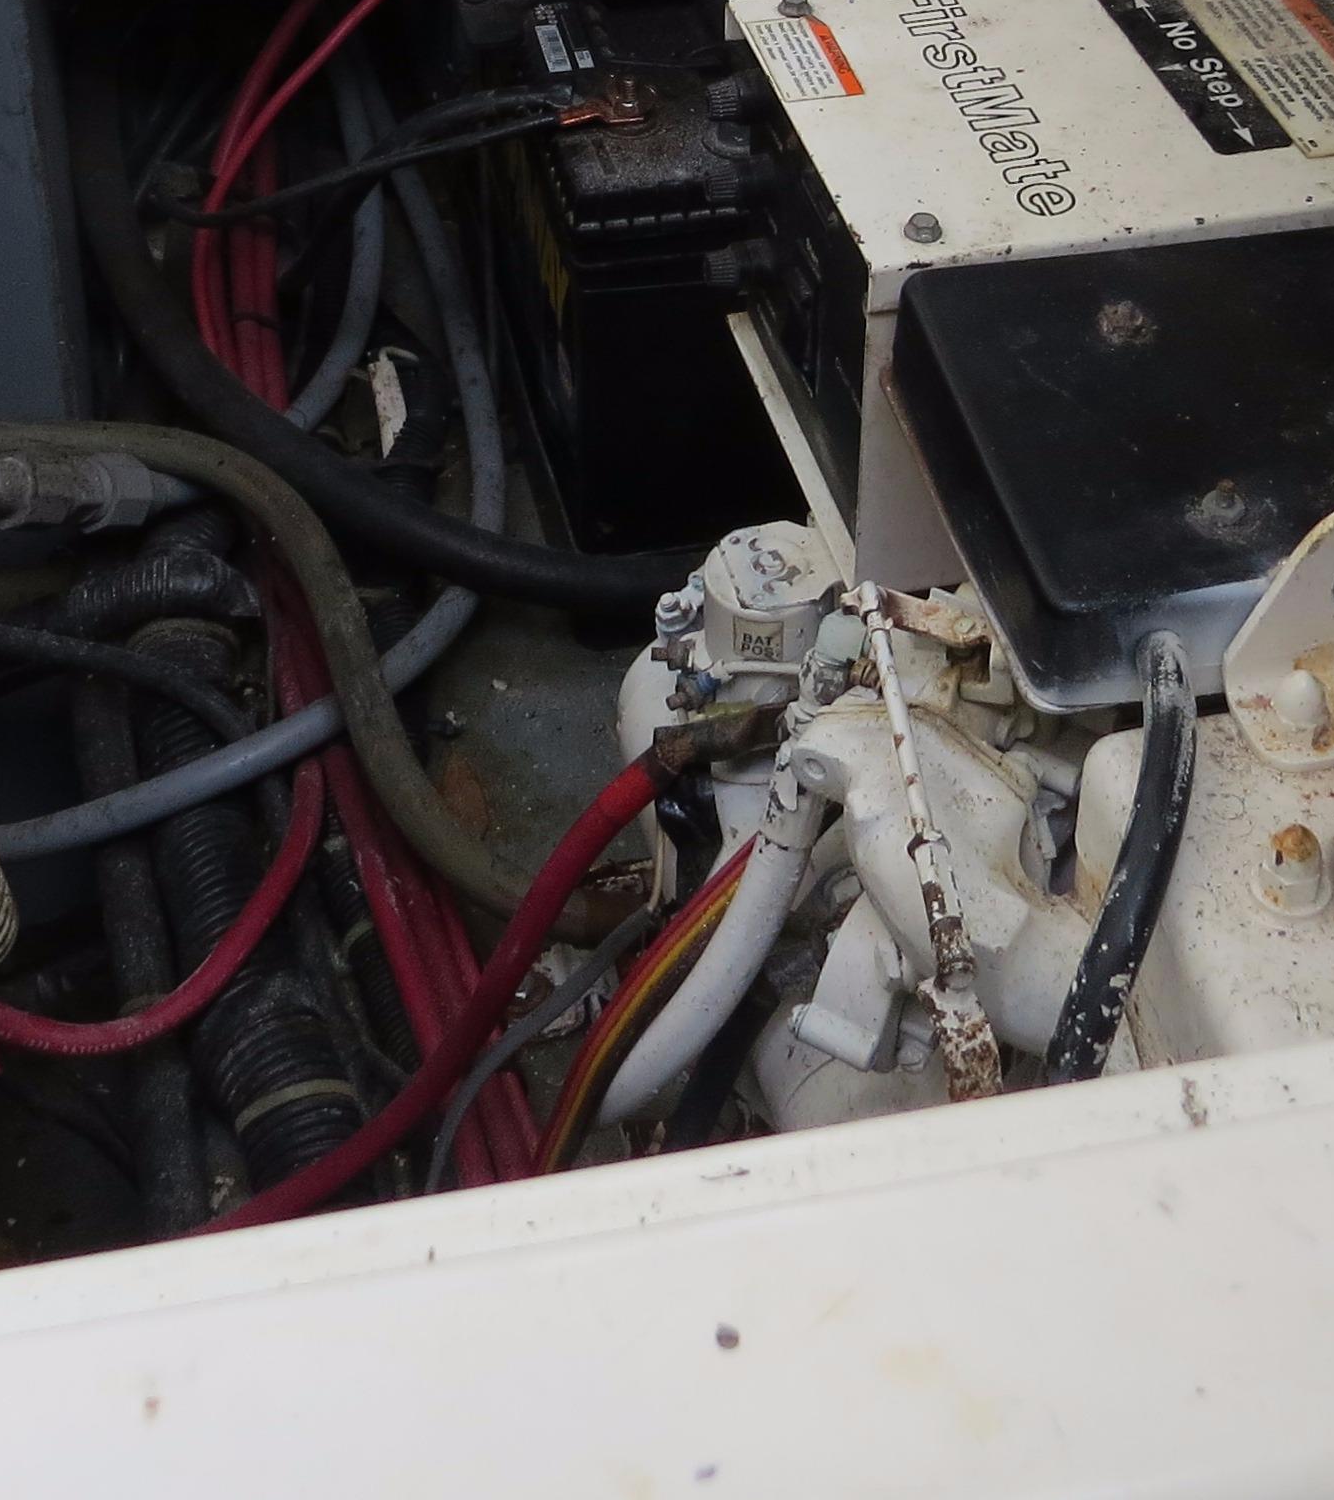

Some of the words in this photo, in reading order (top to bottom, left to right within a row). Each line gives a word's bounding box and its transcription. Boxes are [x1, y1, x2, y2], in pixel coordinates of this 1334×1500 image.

[1158, 20, 1196, 51] No
[1190, 56, 1244, 109] Step
[1256, 63, 1285, 89] present
[1273, 66, 1305, 95] gasoline
[1296, 76, 1324, 100] engine
[742, 633, 780, 647] BAT.
